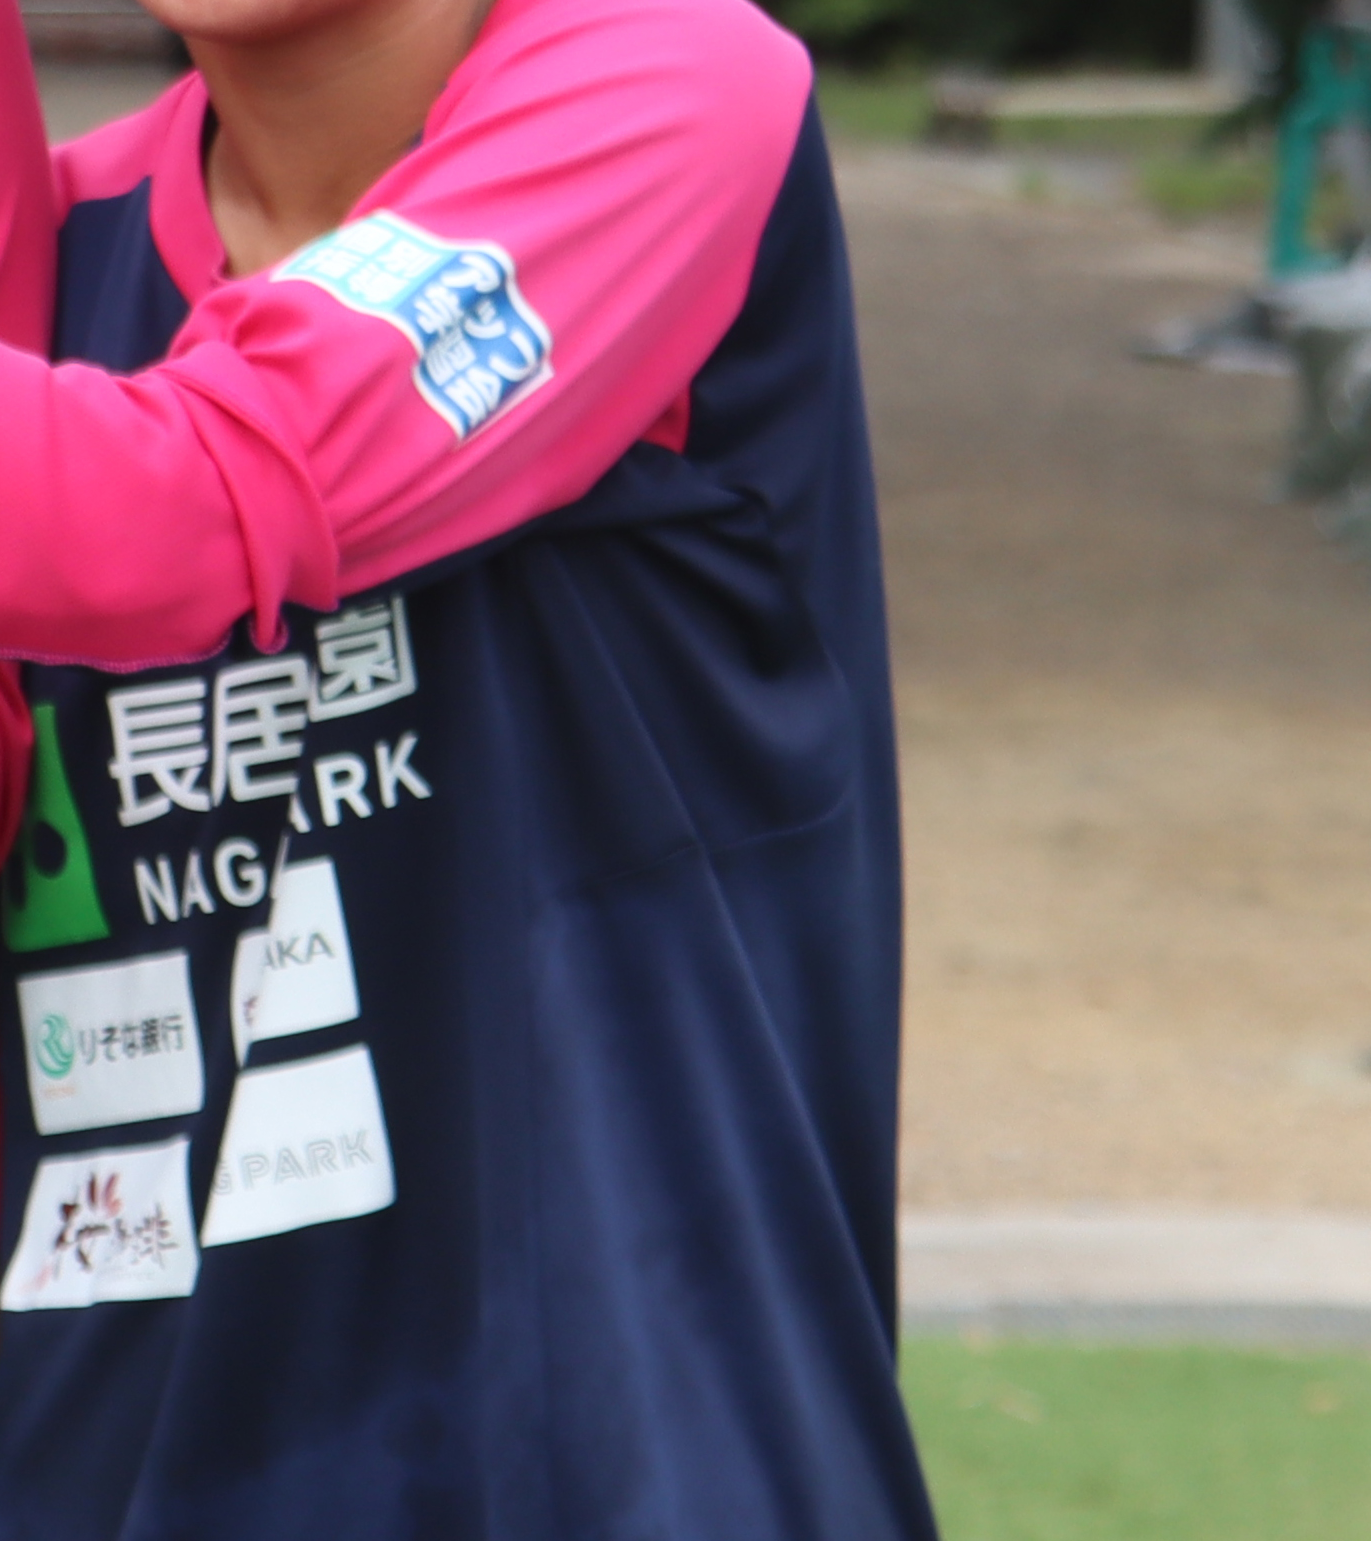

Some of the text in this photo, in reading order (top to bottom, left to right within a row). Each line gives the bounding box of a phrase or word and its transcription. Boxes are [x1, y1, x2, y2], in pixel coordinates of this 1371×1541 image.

[78, 1014, 185, 1066] りそな銀行
[239, 1128, 375, 1191] PARK
